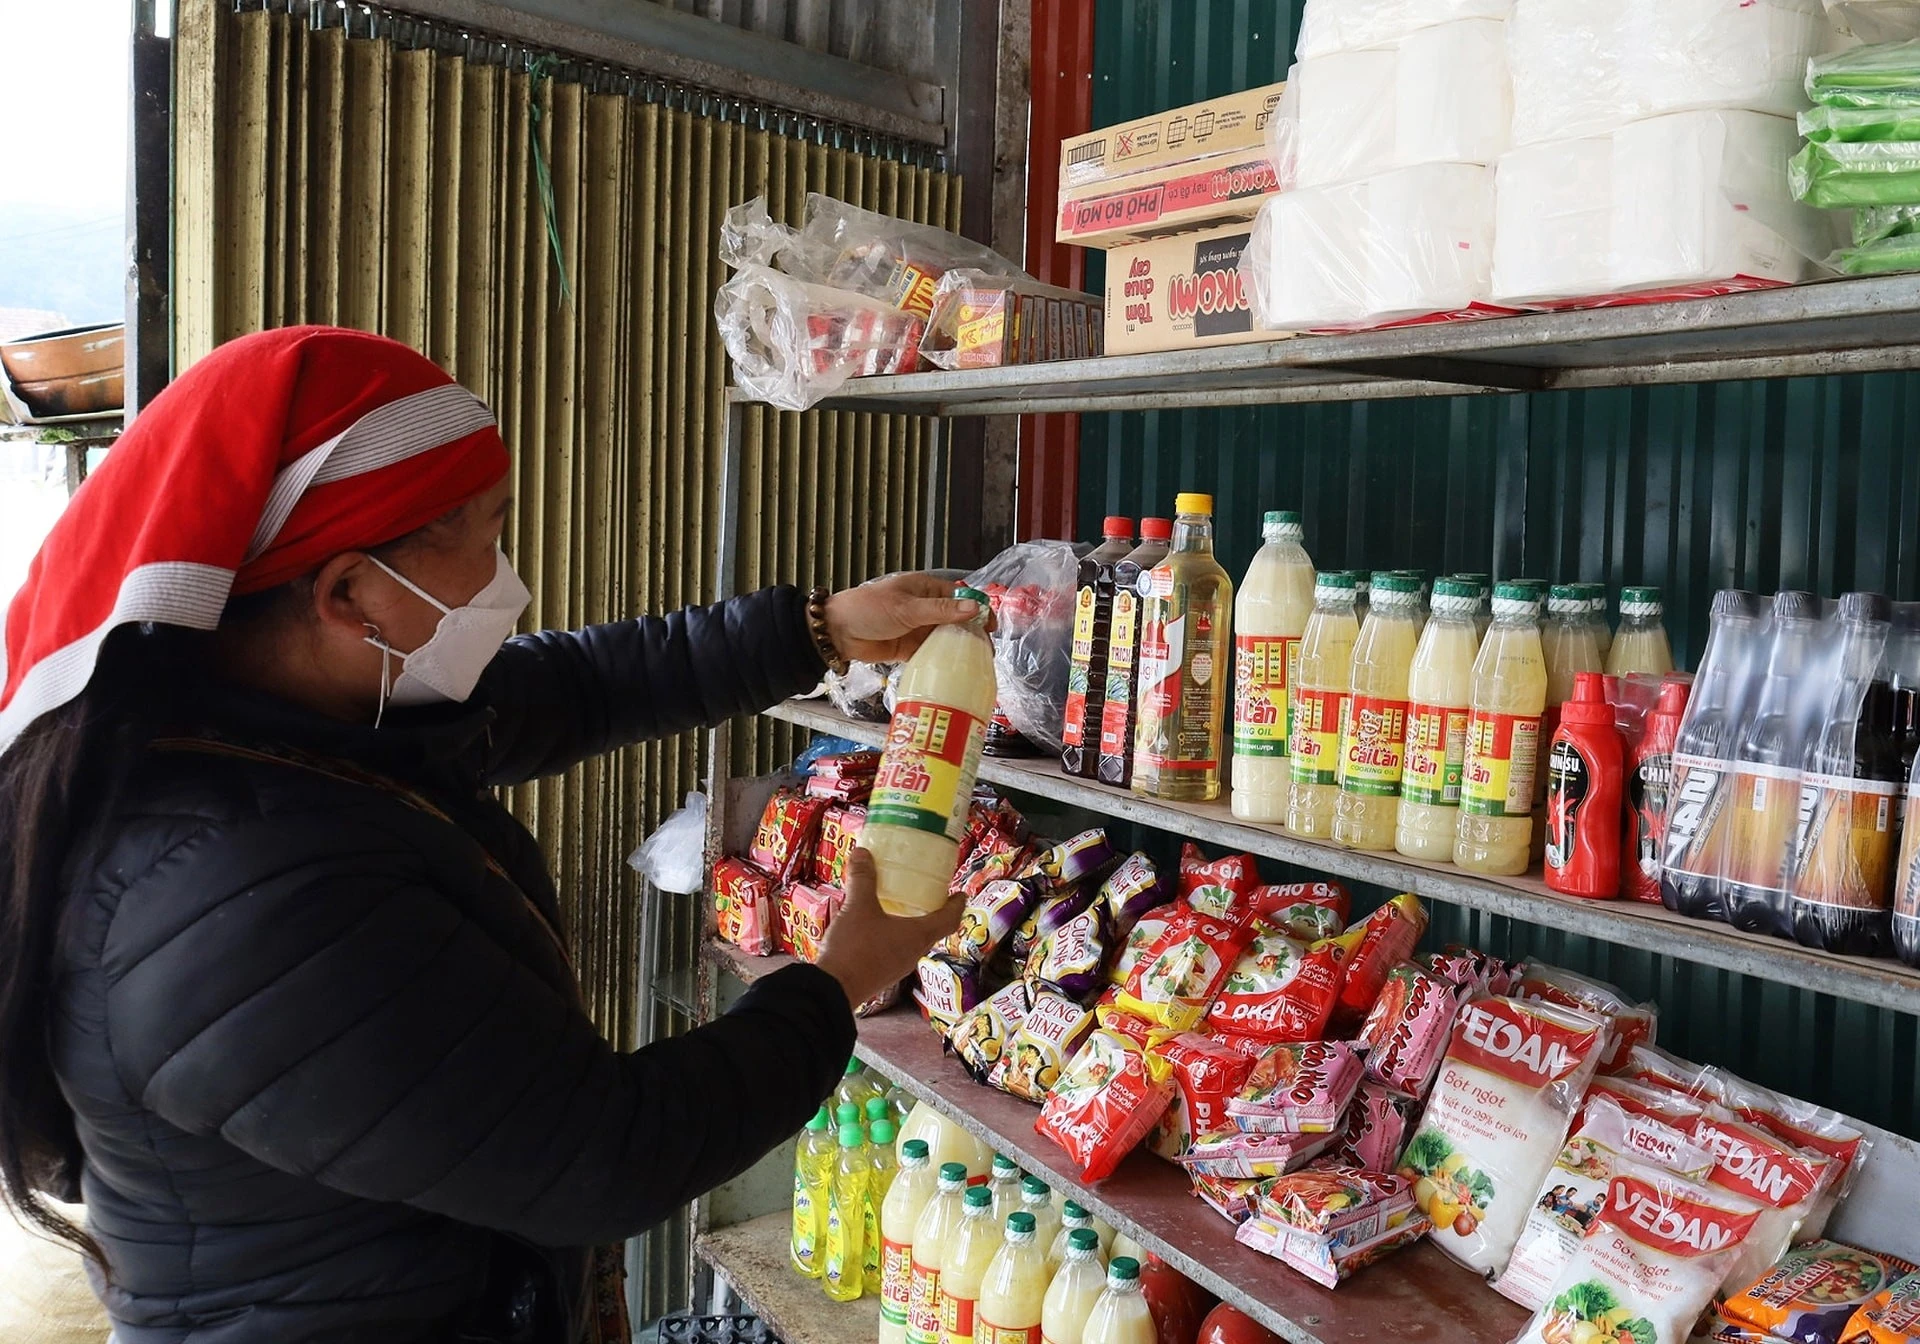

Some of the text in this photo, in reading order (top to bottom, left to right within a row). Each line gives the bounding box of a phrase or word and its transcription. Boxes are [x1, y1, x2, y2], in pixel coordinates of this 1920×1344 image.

[1192, 184, 1207, 194] nay
[1211, 159, 1279, 198] KOKOMI
[1076, 205, 1101, 229] MỚI
[1105, 202, 1123, 224] BÒ
[1127, 194, 1157, 221] PHỞ
[1129, 257, 1151, 279] cay
[1124, 278, 1154, 300] chua
[1168, 268, 1250, 321] OKOMI
[1126, 302, 1153, 325] Tôm
[1257, 728, 1273, 737] OIL
[1350, 765, 1382, 774] COOKING
[1639, 766, 1672, 785] CHIN
[904, 794, 921, 804] OIL
[1071, 915, 1090, 961] CUNG
[920, 965, 951, 994] CUNG
[1037, 996, 1080, 1023] CUNG
[1108, 1087, 1134, 1111] HICKEN
[1443, 1069, 1508, 1109] Bột ngọt
[1441, 1094, 1460, 1110] hiết
[1196, 1101, 1211, 1135] PH
[1693, 1120, 1793, 1202] VEDAN
[1615, 1181, 1732, 1250] VEDAN
[1611, 1237, 1671, 1278] Bột ngọt
[893, 1285, 909, 1303] Lâ
[1748, 1284, 1768, 1299] Bột
[1764, 1269, 1789, 1285] Canh
